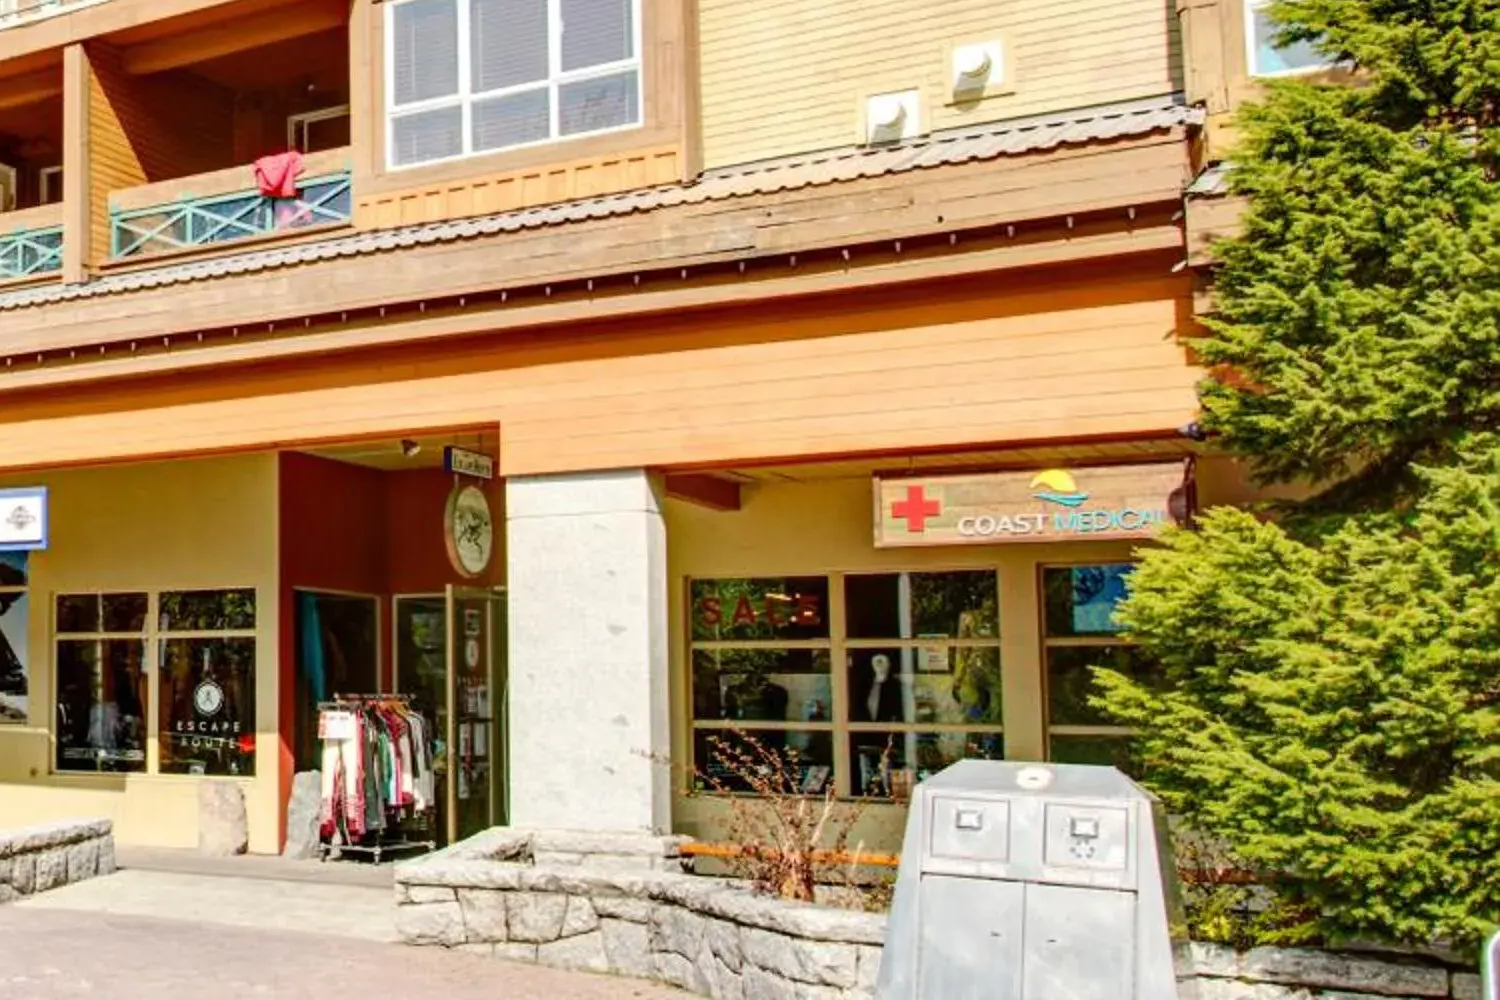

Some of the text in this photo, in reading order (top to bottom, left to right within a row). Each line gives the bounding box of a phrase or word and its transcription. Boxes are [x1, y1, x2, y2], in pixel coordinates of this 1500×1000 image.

[958, 512, 1049, 536] COAST
[701, 592, 821, 626] SALE
[176, 721, 241, 733] ESCAPE
